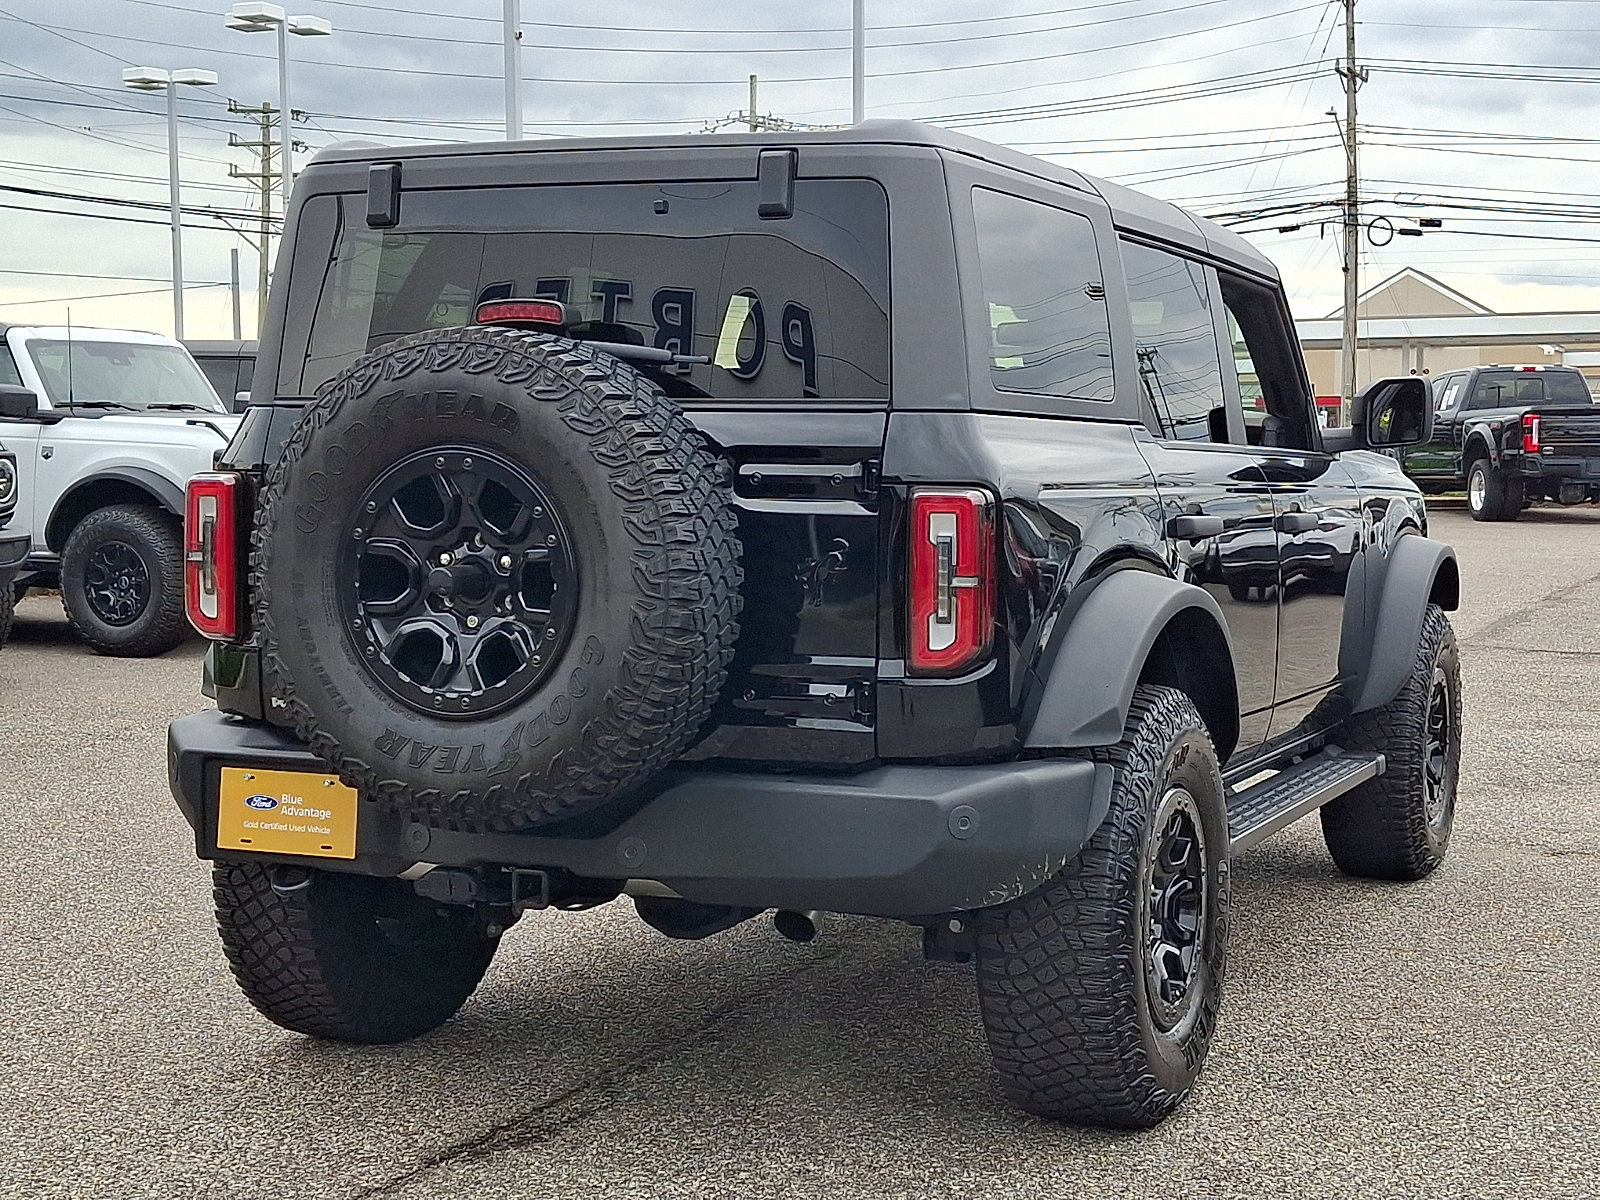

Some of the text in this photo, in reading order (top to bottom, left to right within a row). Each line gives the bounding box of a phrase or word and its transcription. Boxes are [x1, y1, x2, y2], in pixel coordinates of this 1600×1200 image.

[374, 634, 605, 776] GOODYEAR
[248, 796, 275, 809] Ford
[281, 794, 303, 805] Blue
[281, 805, 332, 820] Advantage
[243, 820, 331, 834] Gold Certified Used Vehicle
